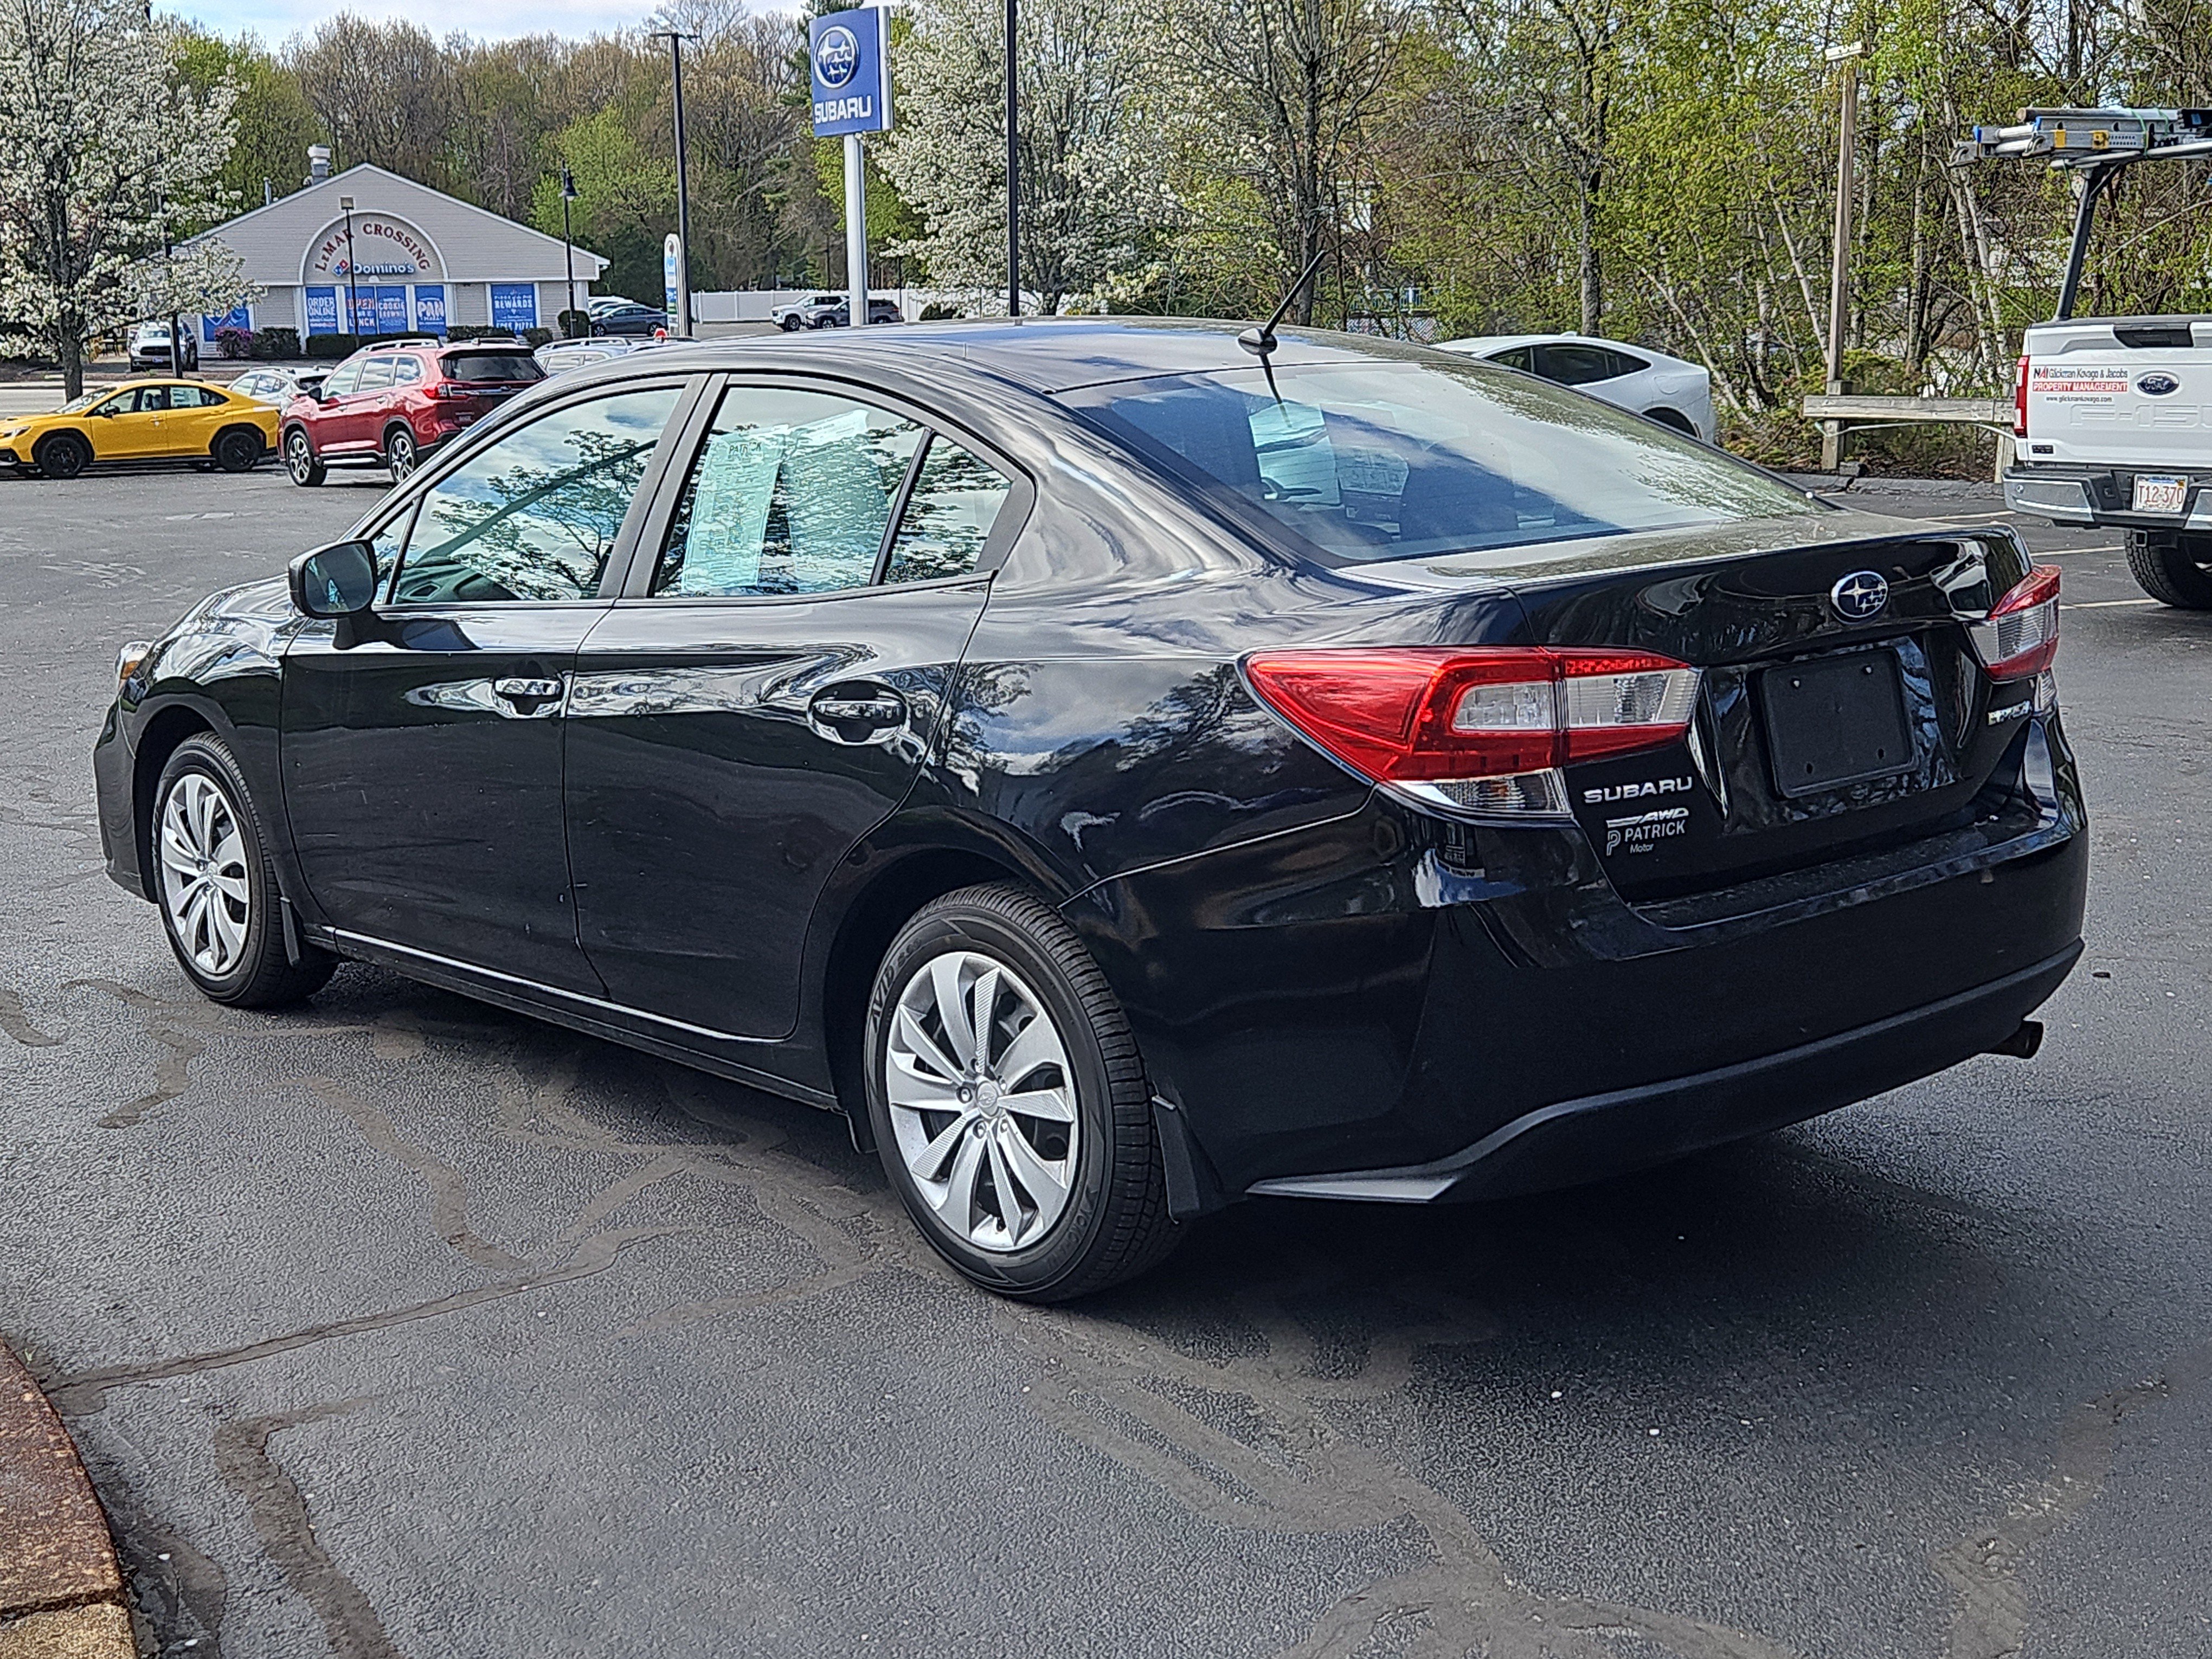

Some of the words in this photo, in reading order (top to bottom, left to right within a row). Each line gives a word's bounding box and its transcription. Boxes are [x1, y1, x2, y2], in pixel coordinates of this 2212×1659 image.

[814, 95, 872, 124] SUBARU
[363, 223, 430, 270] CROSSING
[353, 261, 415, 274] Domino's
[308, 297, 335, 307] ORDER
[494, 299, 532, 309] REWARDS
[308, 307, 335, 316] ONLINE
[417, 301, 444, 317] PAN
[2034, 367, 2048, 379] NAI
[2100, 370, 2104, 378] &
[2106, 368, 2128, 378] Jacobs
[2034, 382, 2072, 391] PROPERTY
[2073, 382, 2128, 391] MANAGEMENT
[1583, 776, 1692, 803] SUBARU
[1624, 820, 1686, 842] PATRICK
[1630, 843, 1654, 854] Motor
[871, 966, 895, 1034] AVID
